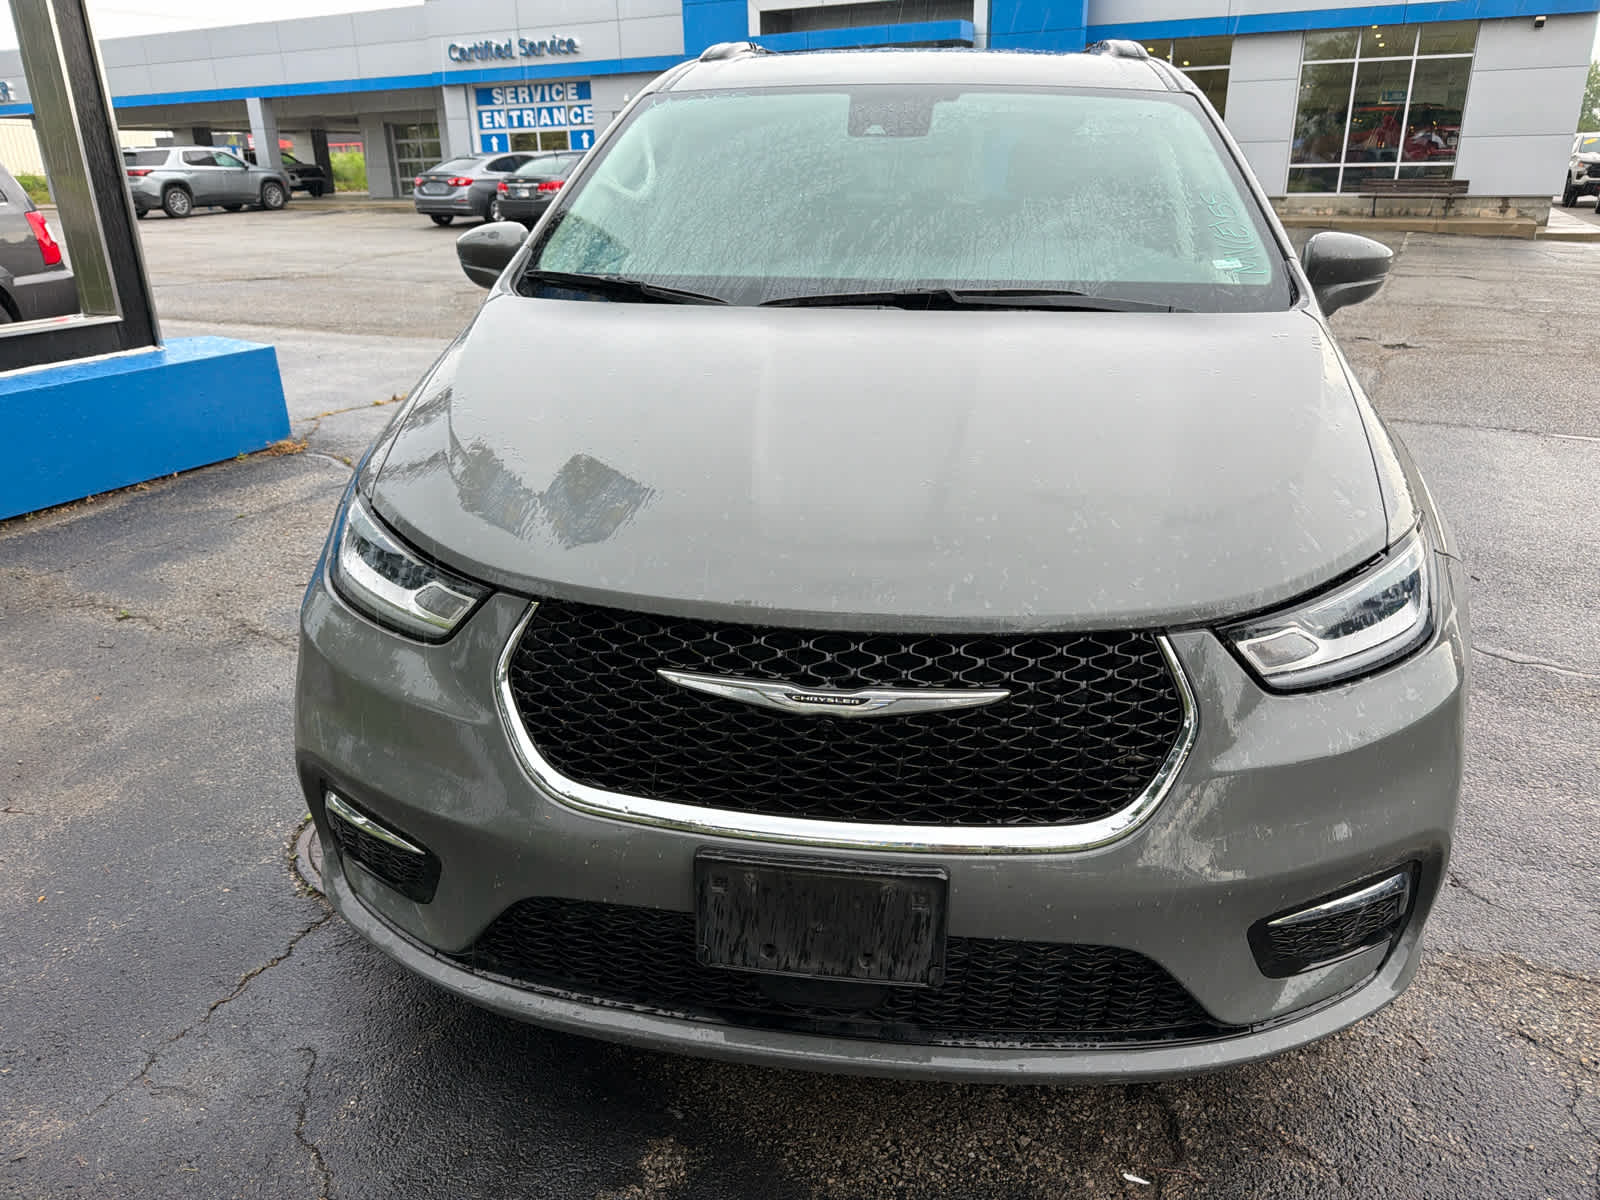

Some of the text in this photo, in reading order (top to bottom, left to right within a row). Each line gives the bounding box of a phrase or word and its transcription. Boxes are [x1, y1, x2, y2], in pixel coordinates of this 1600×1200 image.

[448, 34, 577, 62] Certified Service
[491, 82, 579, 105] SERVICE
[481, 106, 594, 129] ENTRANCE
[792, 694, 860, 705] CHRYSLER
